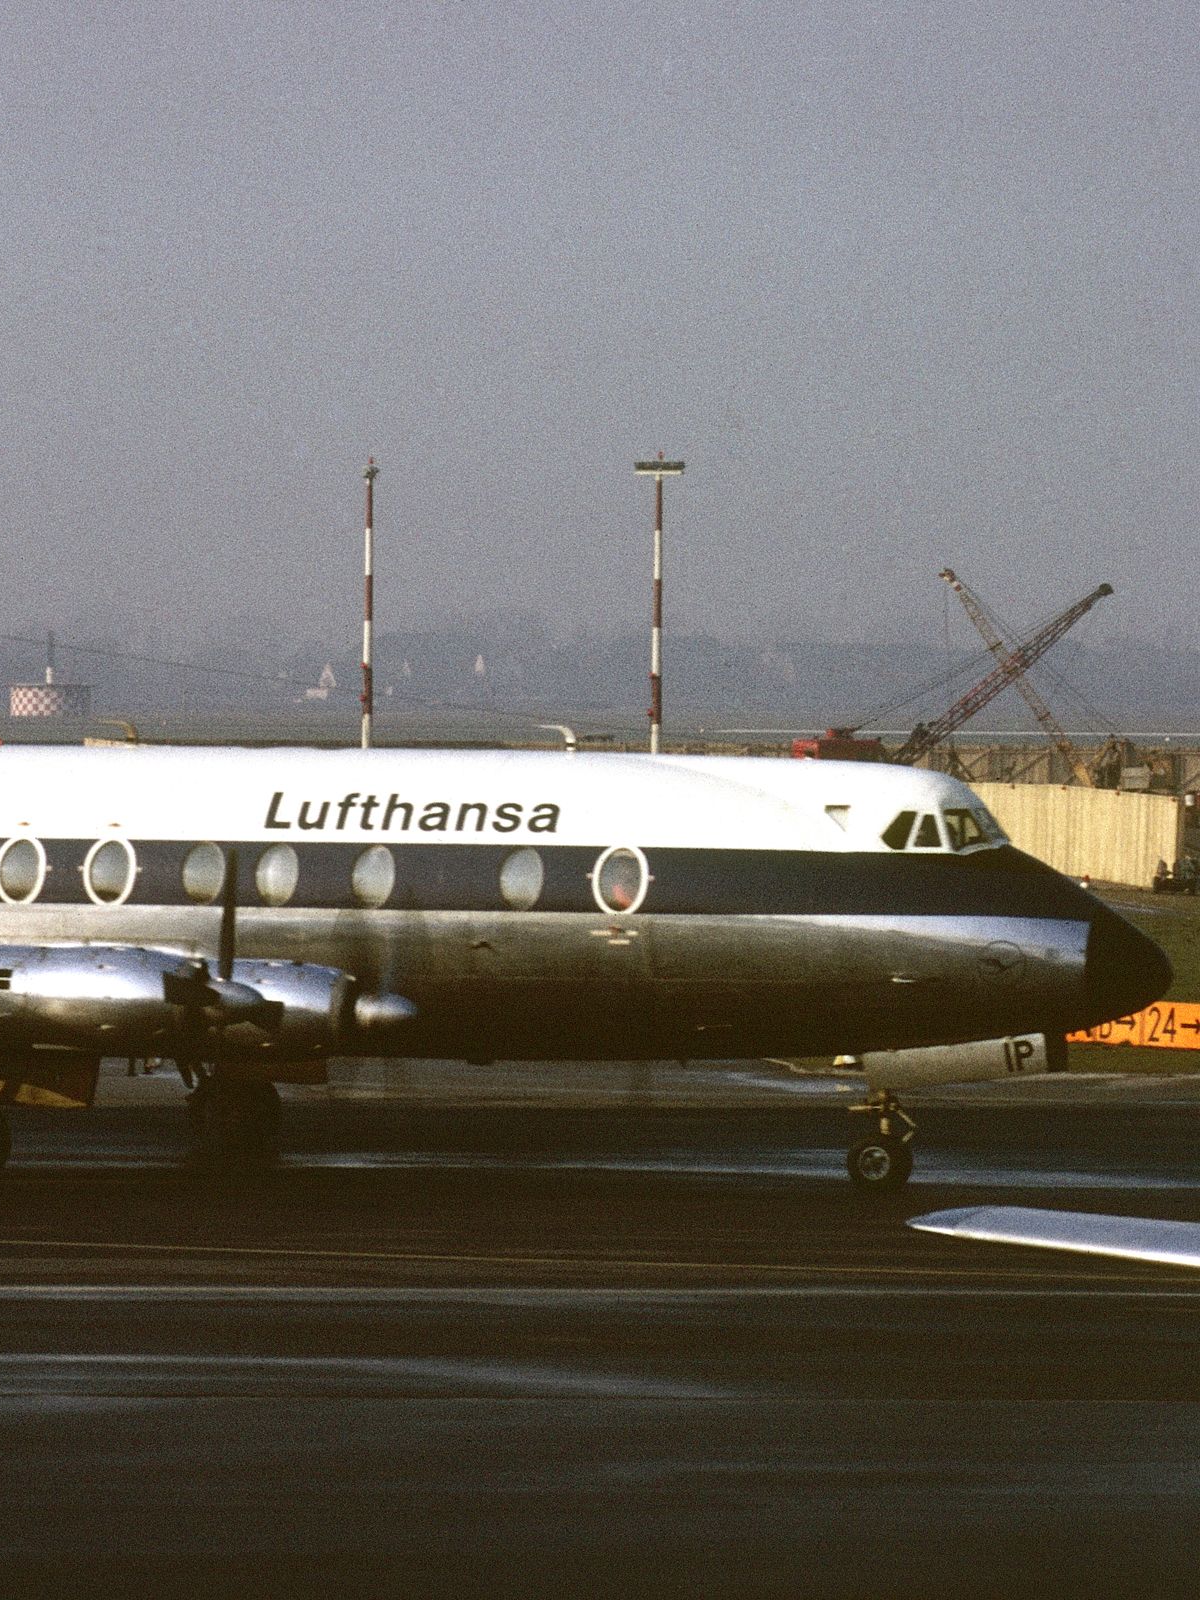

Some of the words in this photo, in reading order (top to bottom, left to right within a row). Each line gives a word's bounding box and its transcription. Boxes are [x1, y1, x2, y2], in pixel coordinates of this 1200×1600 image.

[264, 792, 560, 833] Lufthansa
[1147, 1006, 1177, 1042] 24
[1003, 1040, 1034, 1073] IP
